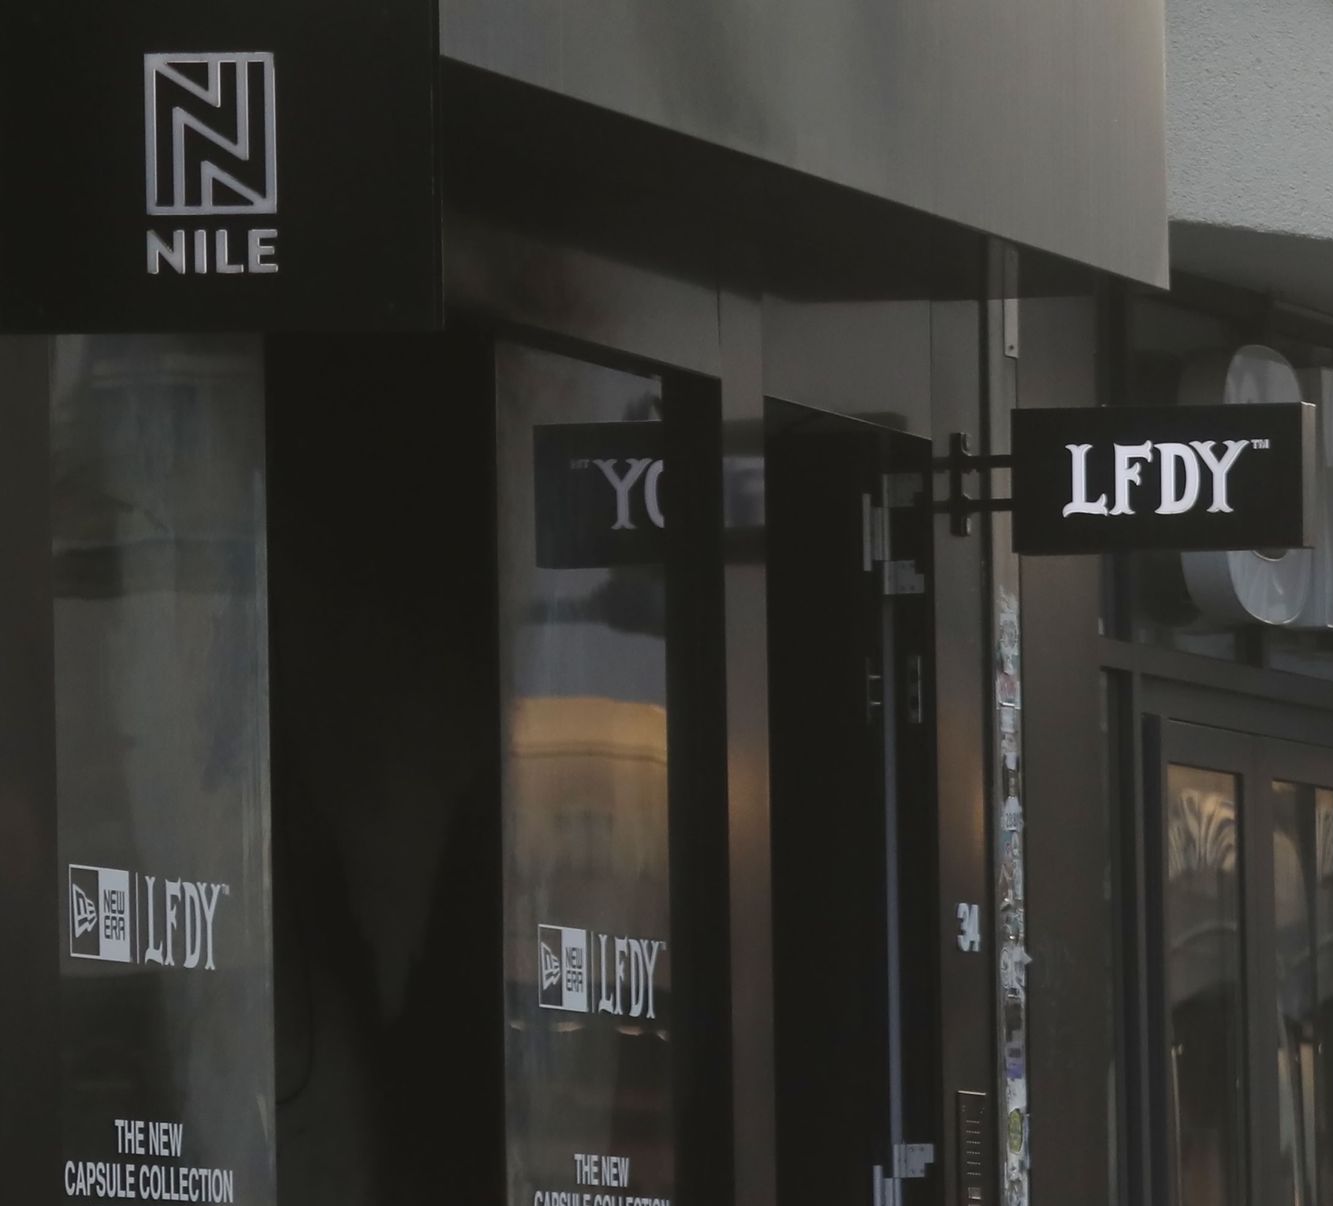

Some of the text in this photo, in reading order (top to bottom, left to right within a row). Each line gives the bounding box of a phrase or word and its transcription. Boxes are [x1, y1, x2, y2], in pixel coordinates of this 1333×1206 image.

[146, 228, 279, 275] NILE
[103, 888, 126, 915] NEW
[103, 916, 126, 941] ERA
[955, 902, 981, 952] 34
[114, 1119, 183, 1158] THE NEW
[64, 1160, 234, 1204] CAPSULE COLLECTION
[574, 1153, 630, 1188] THE NEW
